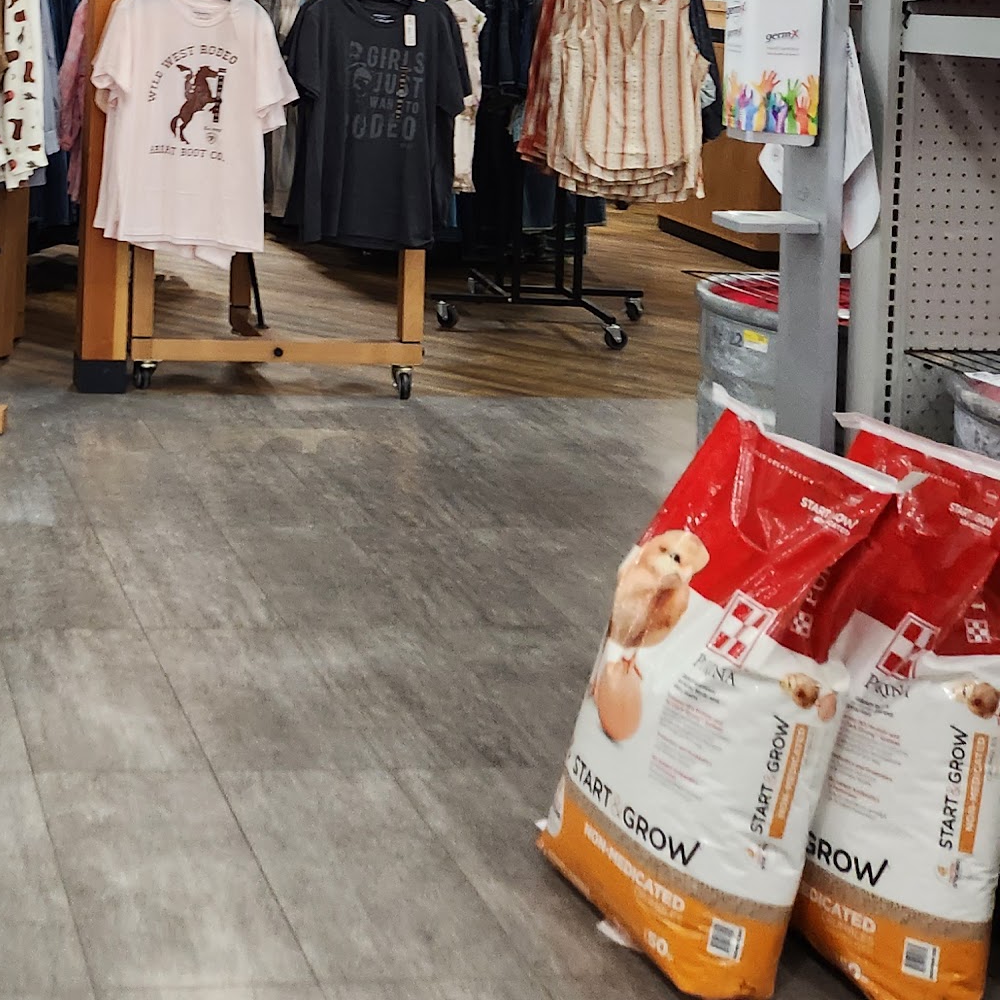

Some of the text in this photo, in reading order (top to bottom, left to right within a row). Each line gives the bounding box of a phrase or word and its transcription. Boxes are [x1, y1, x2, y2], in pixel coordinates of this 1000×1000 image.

[147, 45, 238, 102] WILD WEST RODEO
[181, 148, 207, 158] BOOT
[352, 113, 417, 140] ODEO
[750, 783, 773, 835] START
[767, 715, 789, 773] GROW
[948, 725, 968, 785] GROW
[572, 755, 613, 808] START
[623, 806, 701, 867] GROW
[939, 795, 959, 850] START
